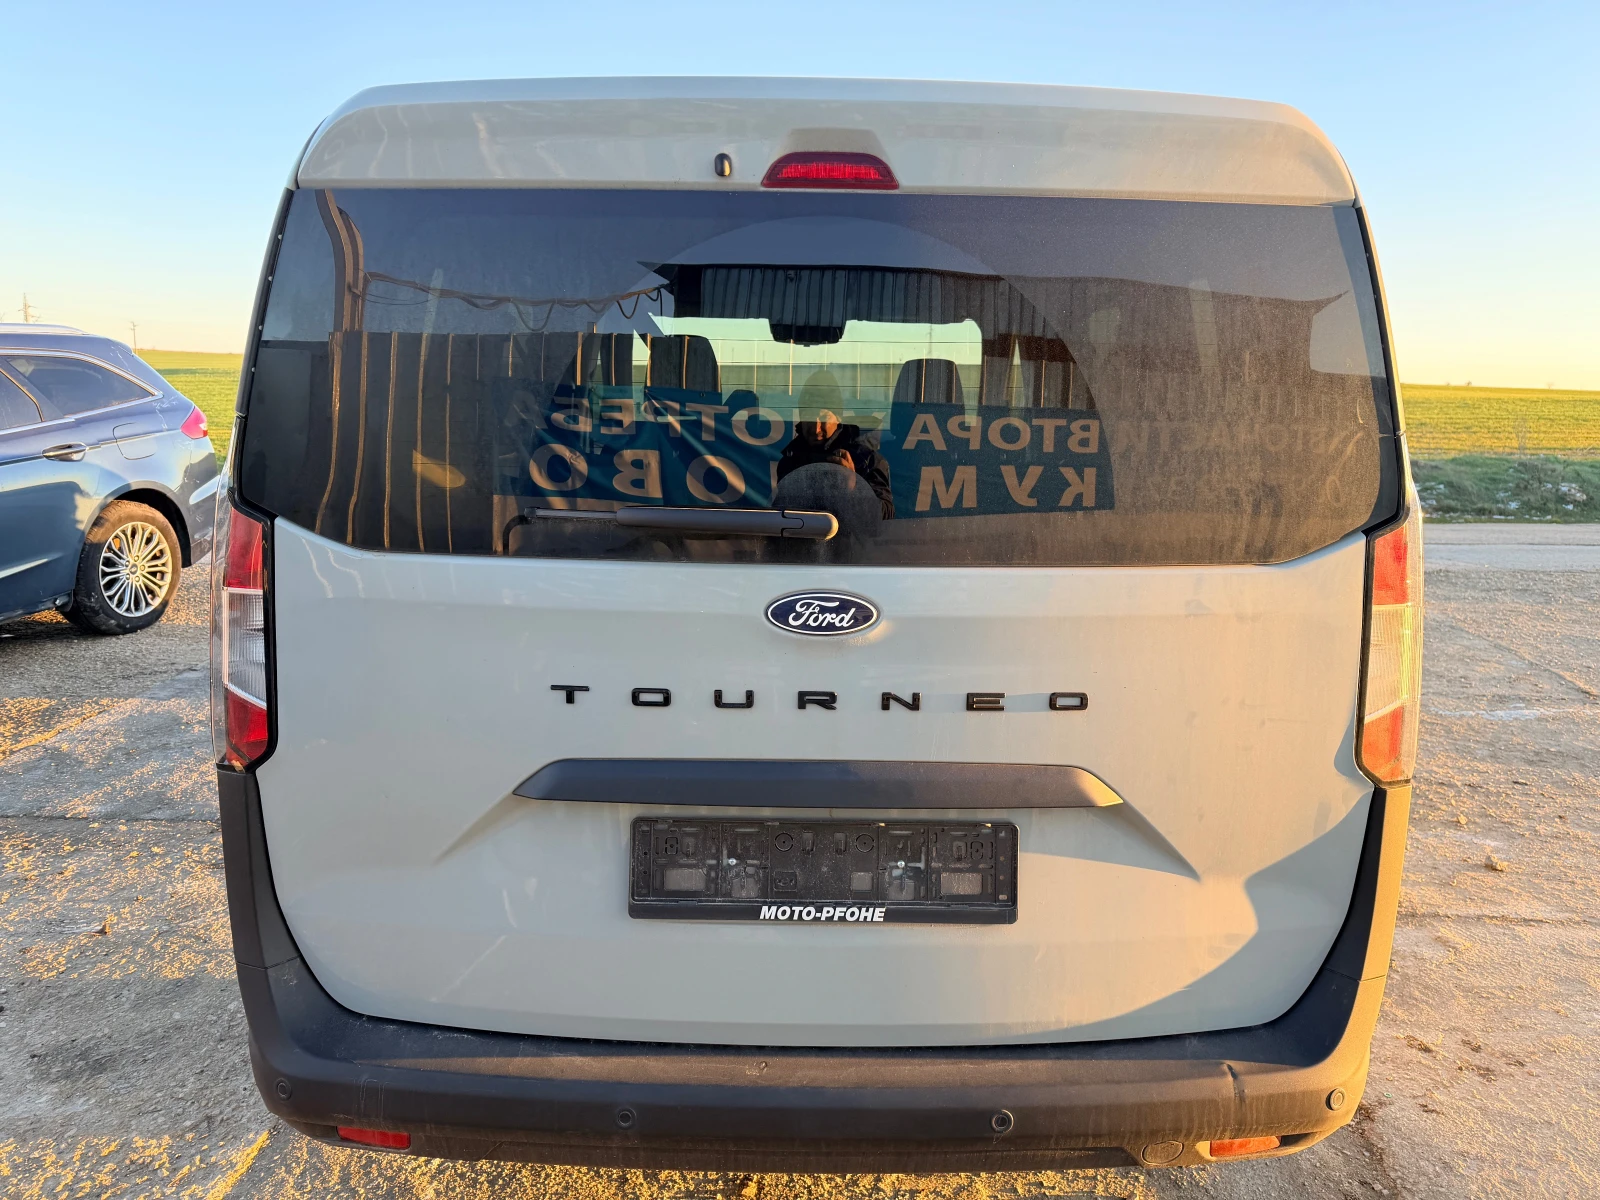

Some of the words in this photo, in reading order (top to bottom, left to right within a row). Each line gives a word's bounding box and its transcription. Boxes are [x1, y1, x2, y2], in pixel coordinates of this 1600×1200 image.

[788, 600, 856, 627] Ford
[550, 684, 1089, 711] TOURNEO
[759, 905, 886, 922] MOTO-PFOHE
